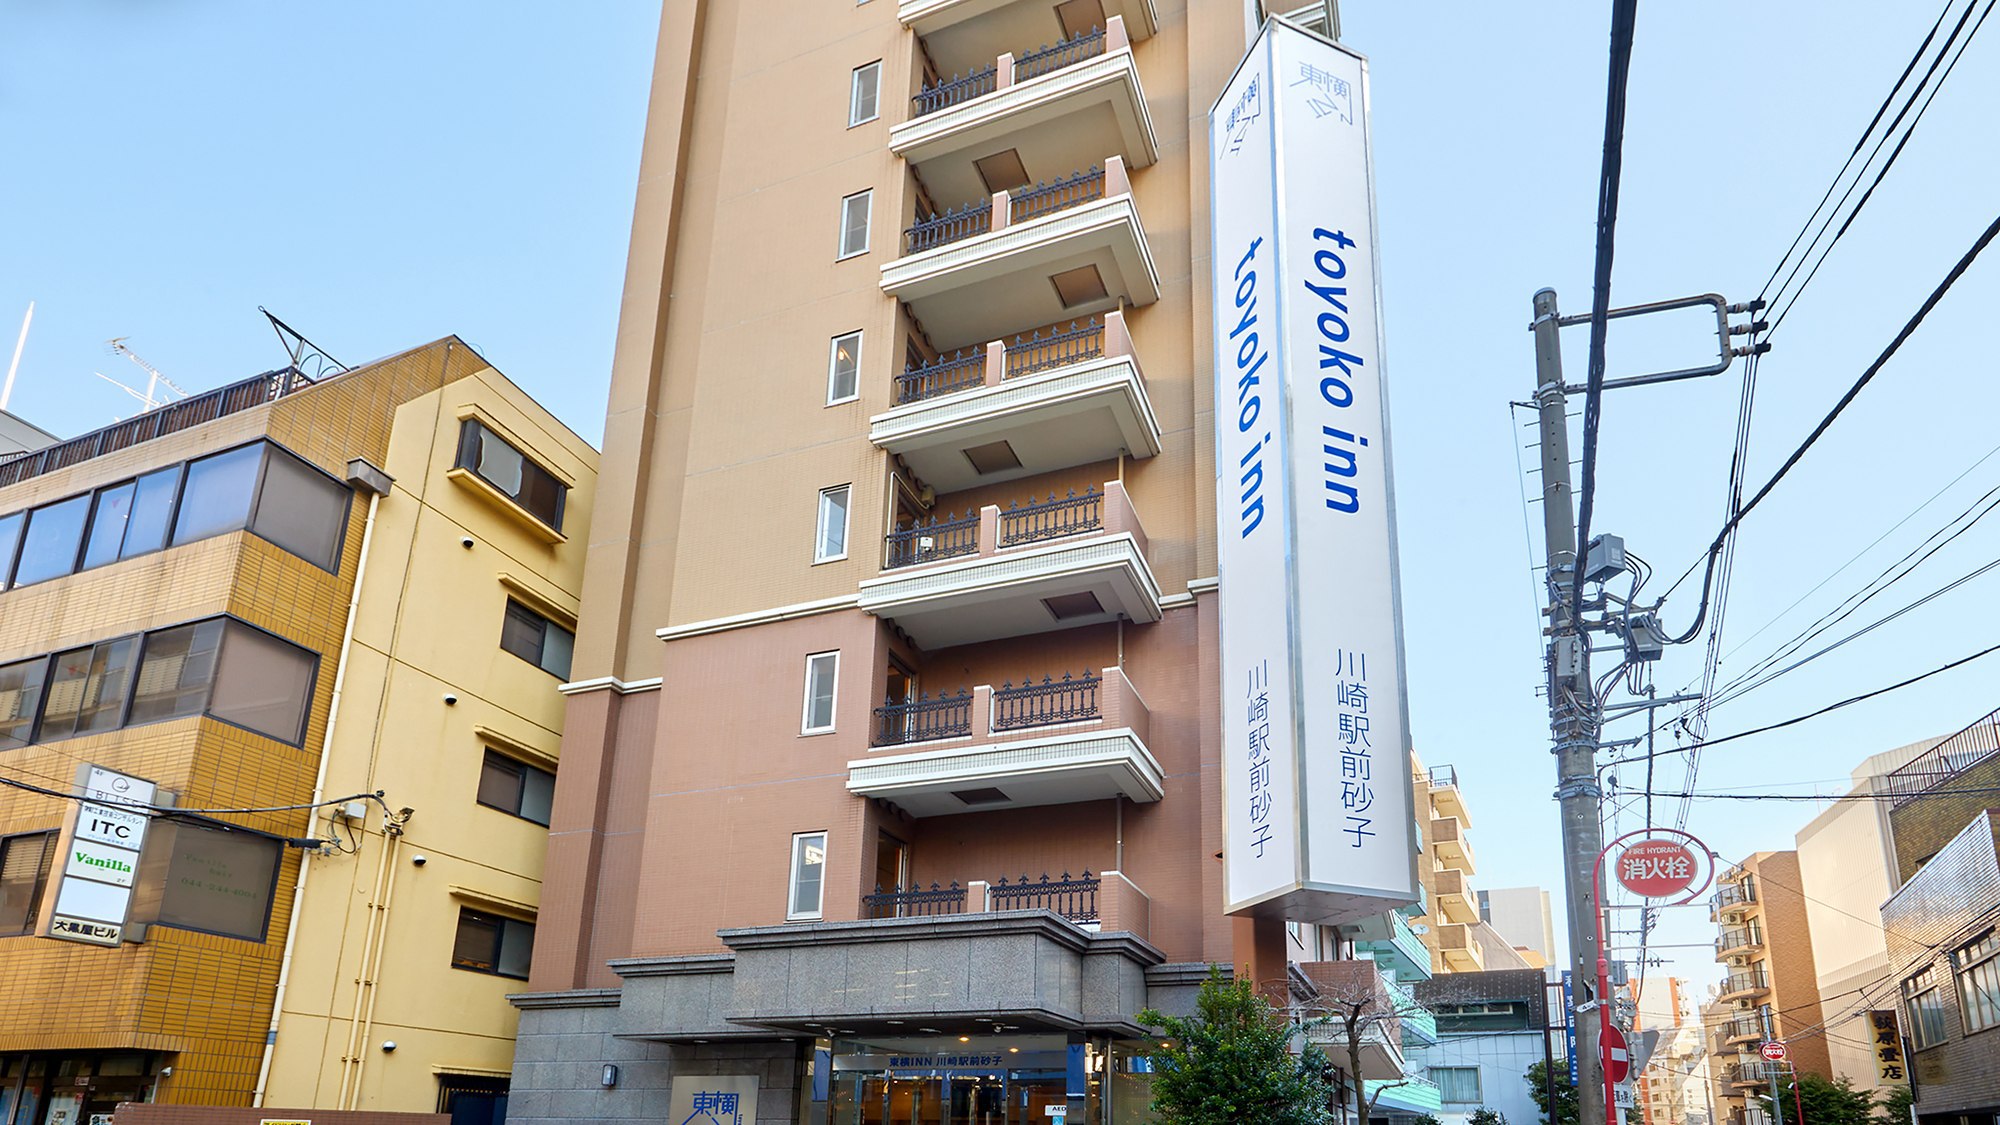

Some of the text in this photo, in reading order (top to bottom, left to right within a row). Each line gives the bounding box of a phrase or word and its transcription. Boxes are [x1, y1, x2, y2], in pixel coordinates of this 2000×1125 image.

[1303, 227, 1368, 514] toyoko inn
[1229, 236, 1271, 539] toyoko inn
[1246, 659, 1273, 858] 川崎駅前砂子
[1335, 648, 1376, 848] 川崎駅前砂子
[91, 819, 131, 839] ITC
[76, 851, 132, 873] Vanilla
[1628, 846, 1681, 855] FIRE HYDRANT
[1623, 856, 1691, 880] 消火栓
[54, 921, 117, 939] 大黒屋ビル
[889, 1055, 1002, 1067] 東横INN 川崎駅前砂子
